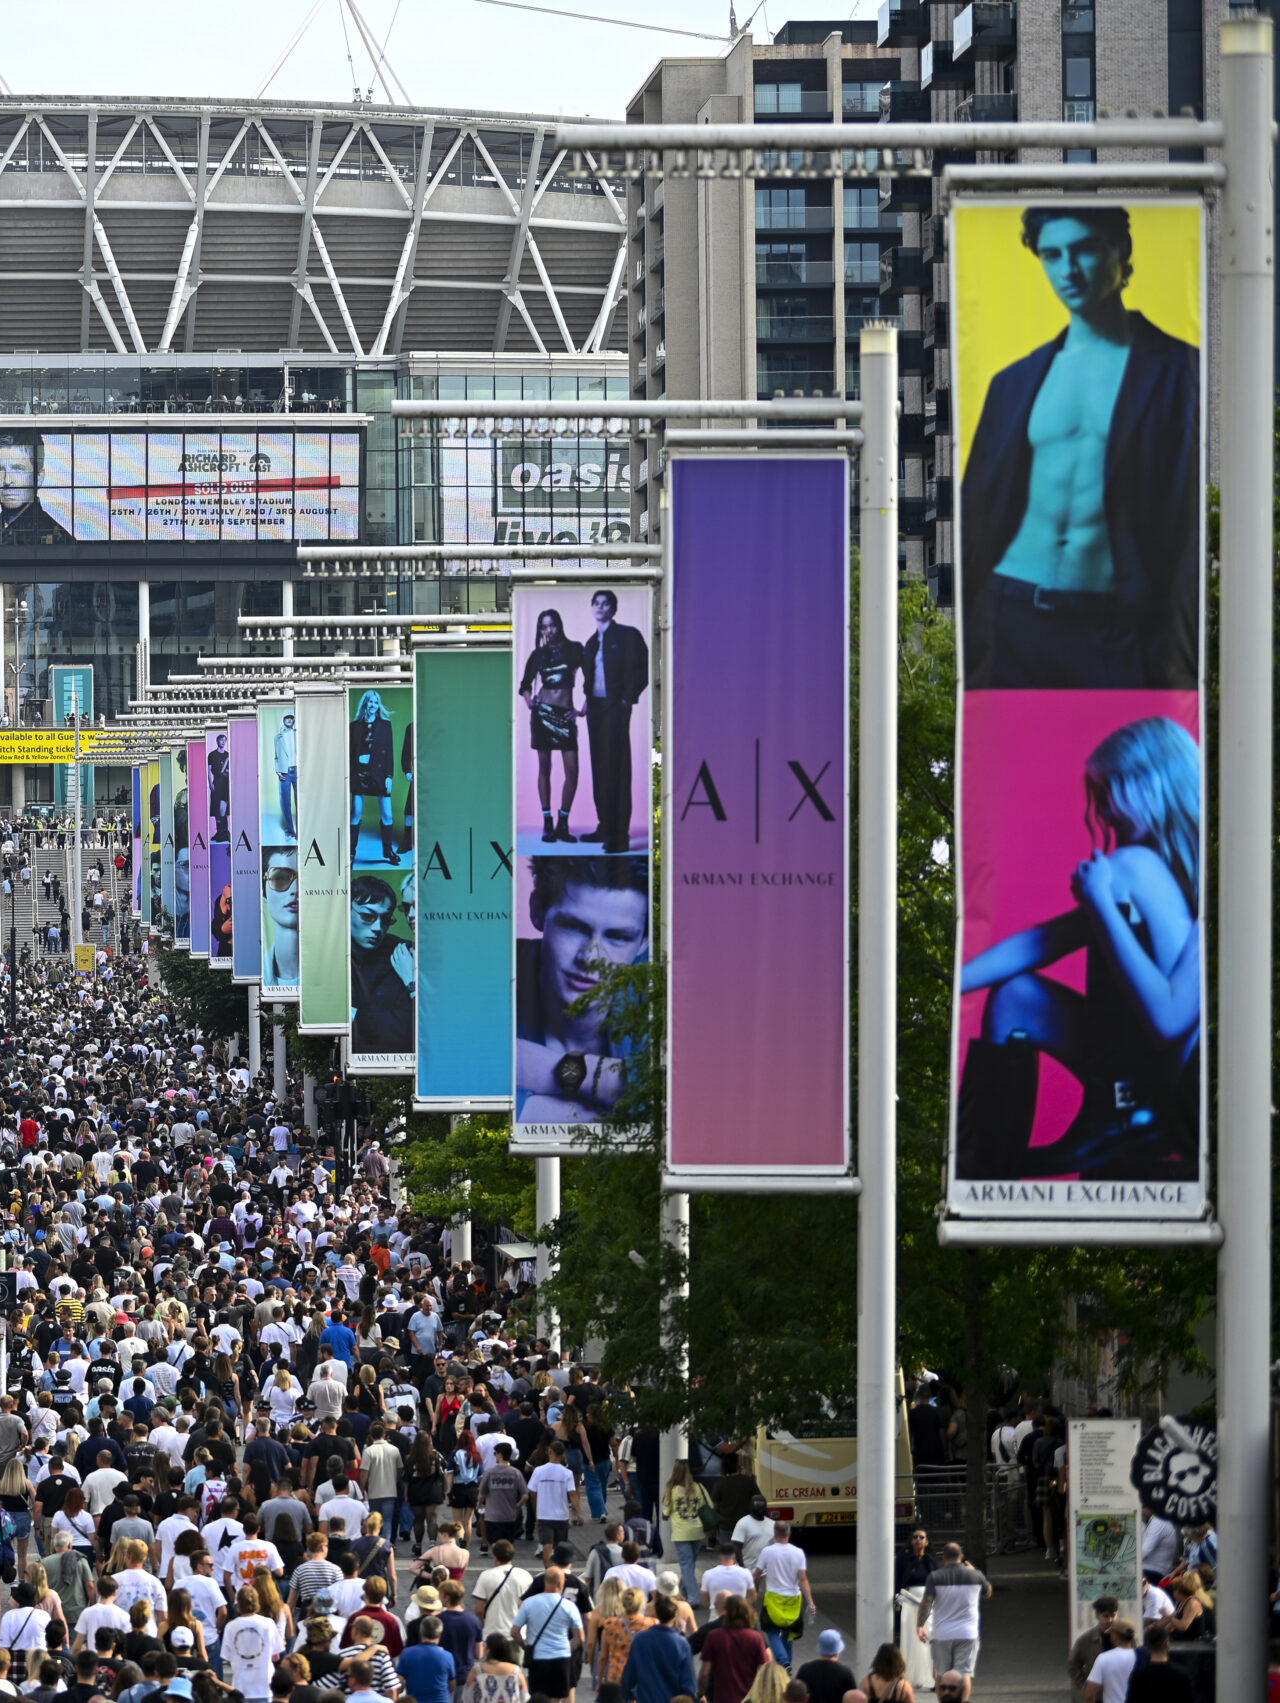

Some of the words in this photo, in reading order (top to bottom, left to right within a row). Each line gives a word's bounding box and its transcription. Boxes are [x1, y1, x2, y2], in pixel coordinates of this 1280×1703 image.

[183, 454, 236, 463] RICHARD
[178, 463, 240, 472] ASHCROFT
[250, 464, 271, 472] CAST
[194, 482, 227, 495] SOLD
[231, 480, 255, 493] OUT
[58, 733, 85, 741] Guets
[18, 746, 54, 755] Standing
[680, 872, 743, 886] ARMANI
[751, 872, 837, 886] EXCHANGE
[423, 912, 462, 920] ARMANI
[357, 1054, 389, 1062] ARMANI
[523, 1125, 571, 1135] ARMANI
[965, 1184, 1054, 1202] ARMANI
[1067, 1184, 1186, 1203] EXCHANGE
[92, 1365, 116, 1373] oasis
[776, 1488, 789, 1498] ICE
[792, 1487, 826, 1497] CREAM
